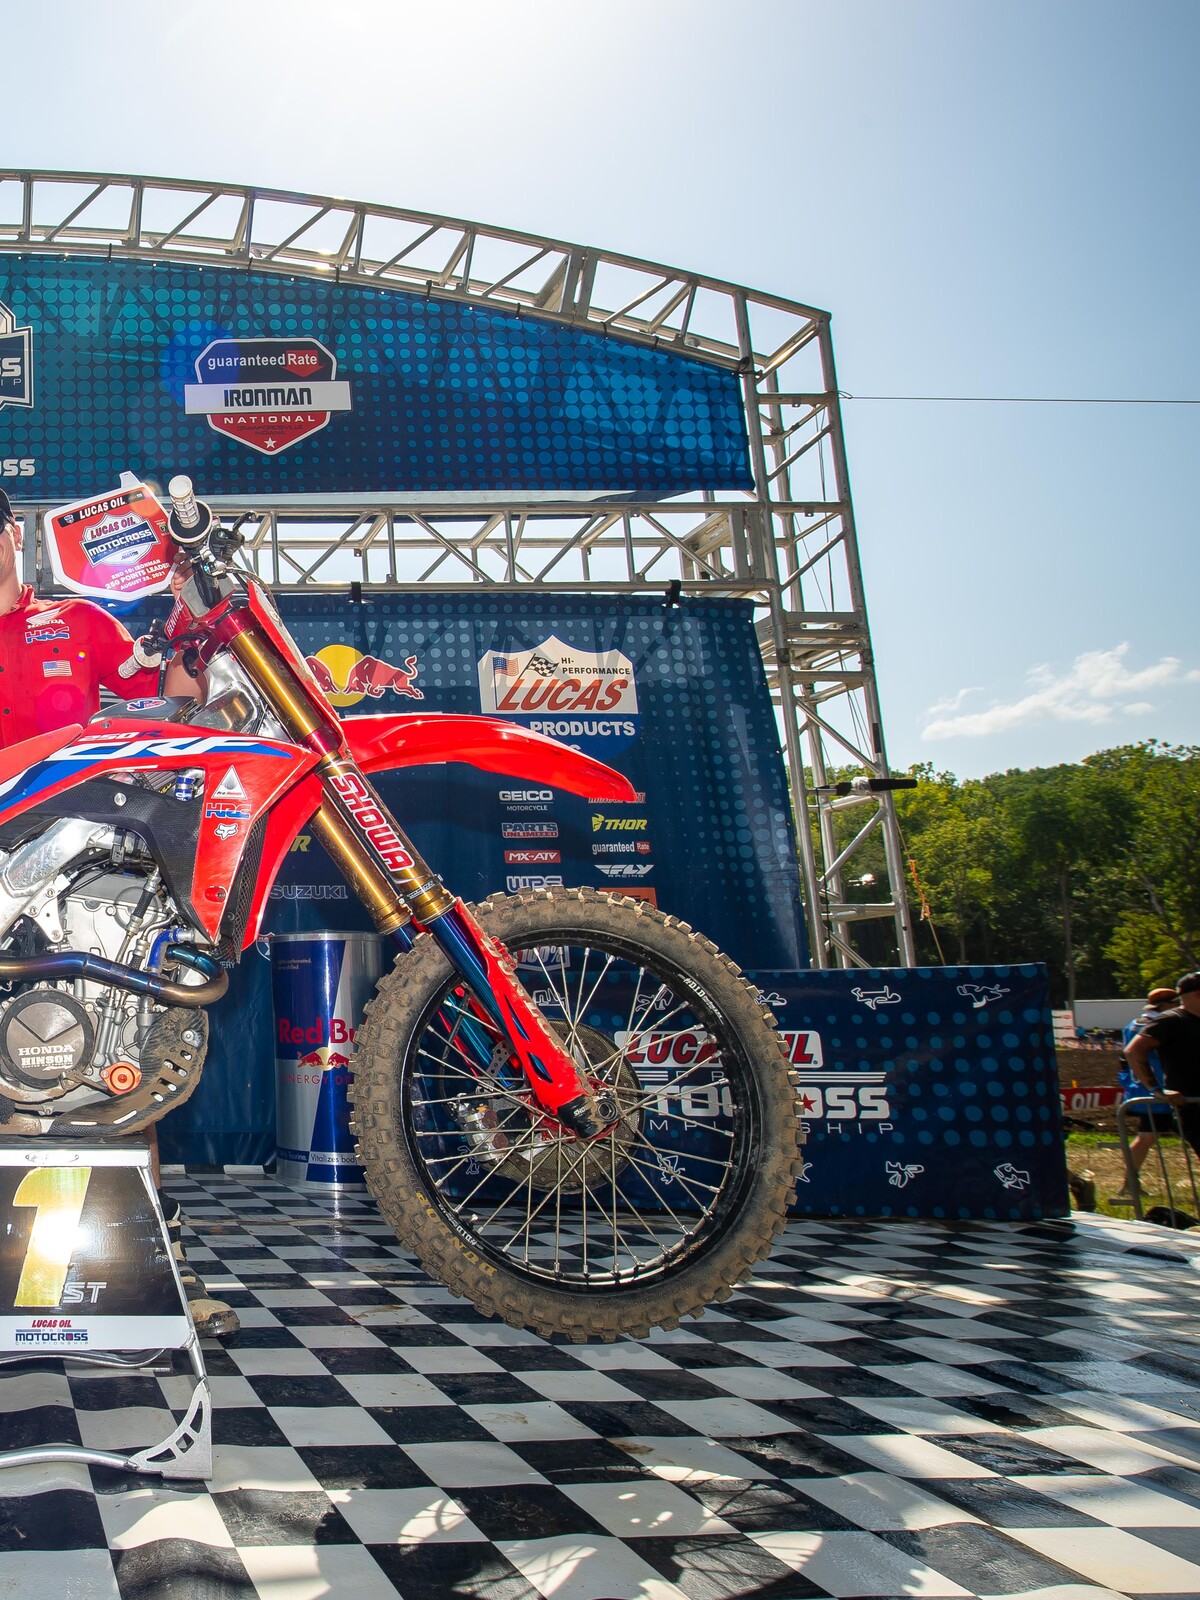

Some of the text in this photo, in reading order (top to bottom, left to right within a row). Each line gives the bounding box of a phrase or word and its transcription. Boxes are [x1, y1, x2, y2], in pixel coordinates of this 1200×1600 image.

[208, 353, 318, 370] guaranteed Rate
[223, 387, 312, 407] IRONMAN
[223, 415, 315, 424] NATIONAL
[79, 496, 126, 519] LUCAS OIL
[90, 517, 136, 539] LUCAS OIL
[88, 529, 152, 556] MOTOCROSS
[120, 569, 147, 583] POINTS
[496, 679, 629, 711] LUCAS
[530, 721, 636, 736] PRODUCTS
[498, 790, 554, 801] GEICO
[205, 802, 252, 819] HRC
[328, 772, 415, 872] SHOWA
[502, 822, 558, 832] PARTS
[605, 819, 648, 830] THOR
[592, 841, 650, 855] guaranteed Rate
[598, 864, 655, 875] FLY
[269, 885, 349, 899] SUZUKI
[279, 1017, 323, 1045] Red
[17, 1044, 76, 1056] HONDA
[625, 1033, 722, 1064] LUCA
[21, 1054, 73, 1066] HINSON
[1071, 1091, 1095, 1110] OIL
[310, 1153, 340, 1162] Vitalizes
[32, 1319, 72, 1328] LUCAS OIL
[15, 1332, 89, 1342] MOTOCROSS
